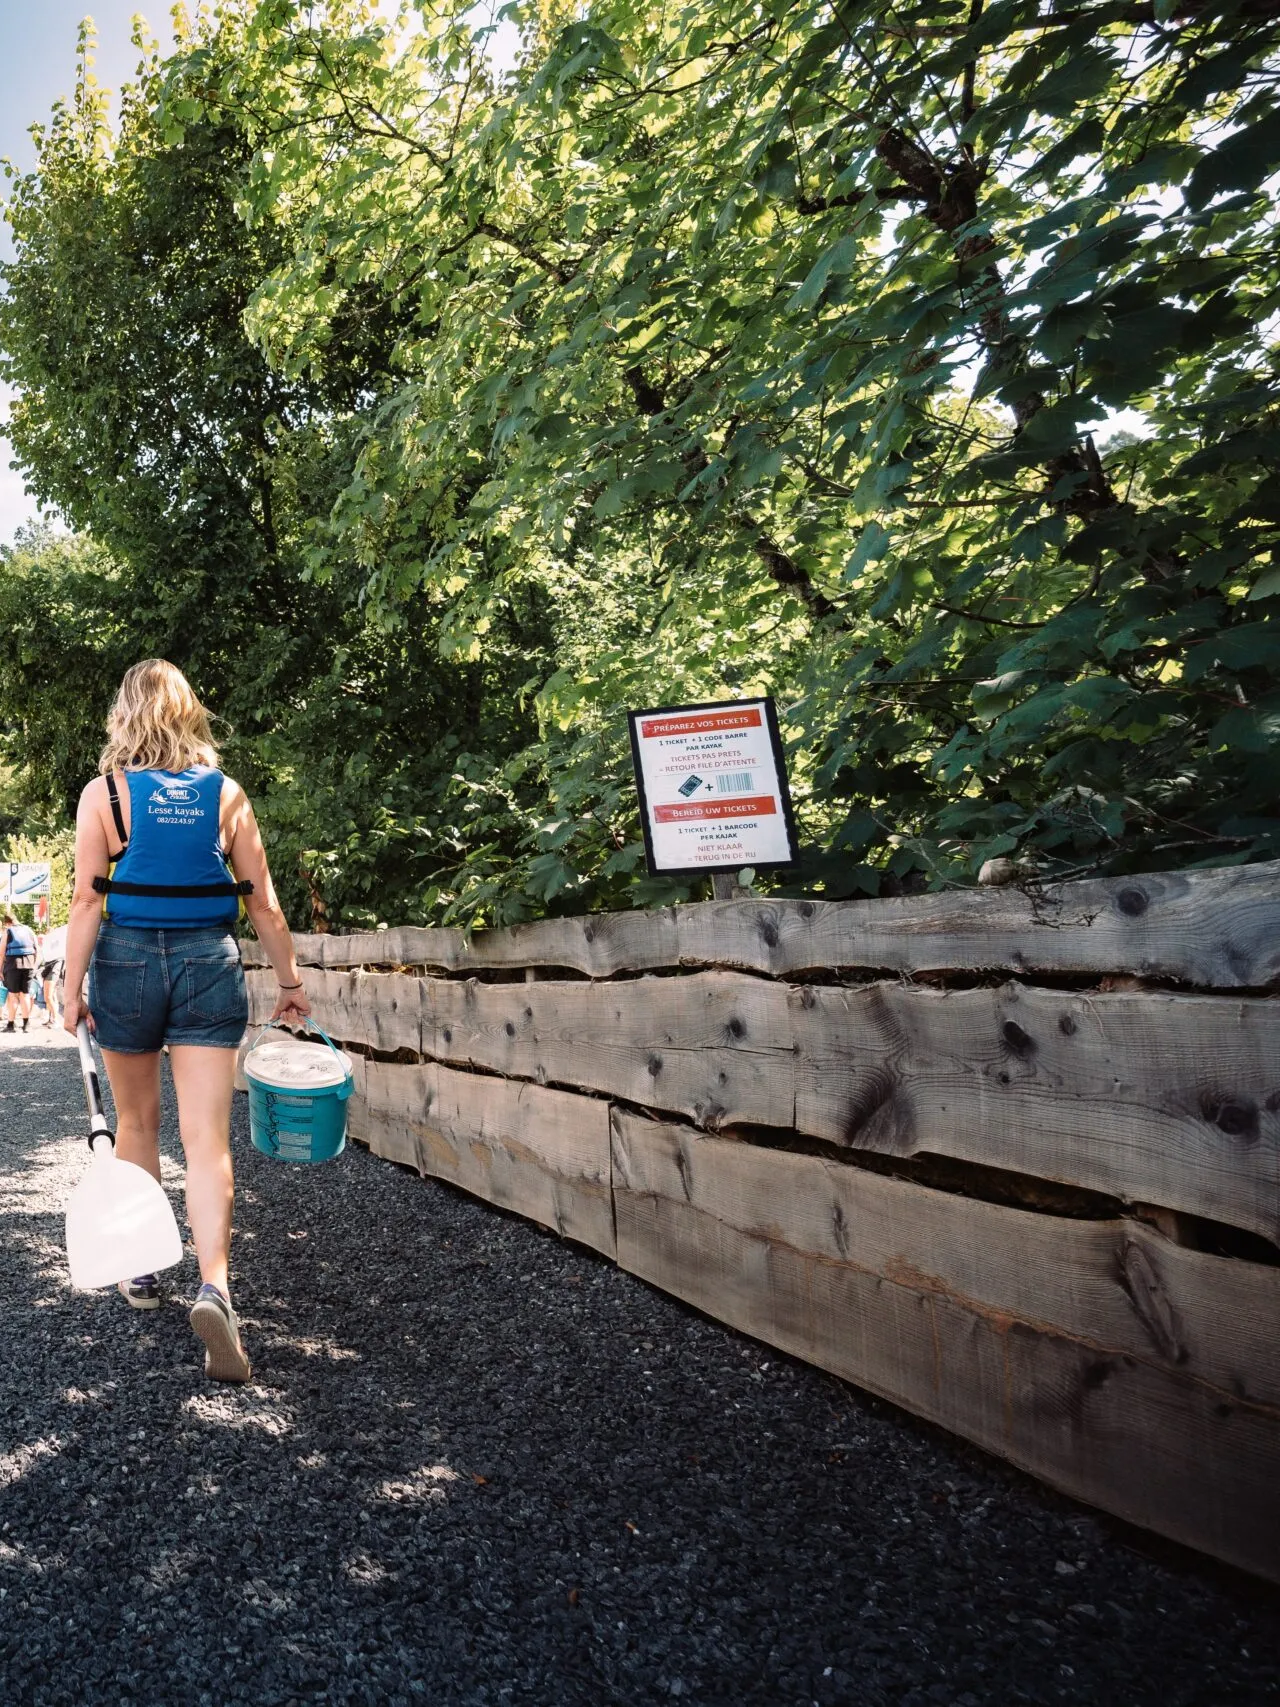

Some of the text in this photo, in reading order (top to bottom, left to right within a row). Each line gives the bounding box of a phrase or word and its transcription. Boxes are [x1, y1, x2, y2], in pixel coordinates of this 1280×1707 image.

[697, 720, 714, 728] VOS
[716, 716, 749, 725] TICKETS
[724, 732, 748, 740] BARRE
[671, 754, 700, 762] TICKETS
[702, 752, 716, 760] PAS
[665, 764, 696, 772] RETOUR
[148, 805, 205, 817] Lesse kayaks
[672, 804, 757, 817] BEREID UW TICKETS
[156, 817, 196, 825] 082/22.43.97
[724, 822, 758, 830] BARCODE
[697, 842, 743, 852] NIET KLAAR
[694, 854, 720, 862] TERUG
